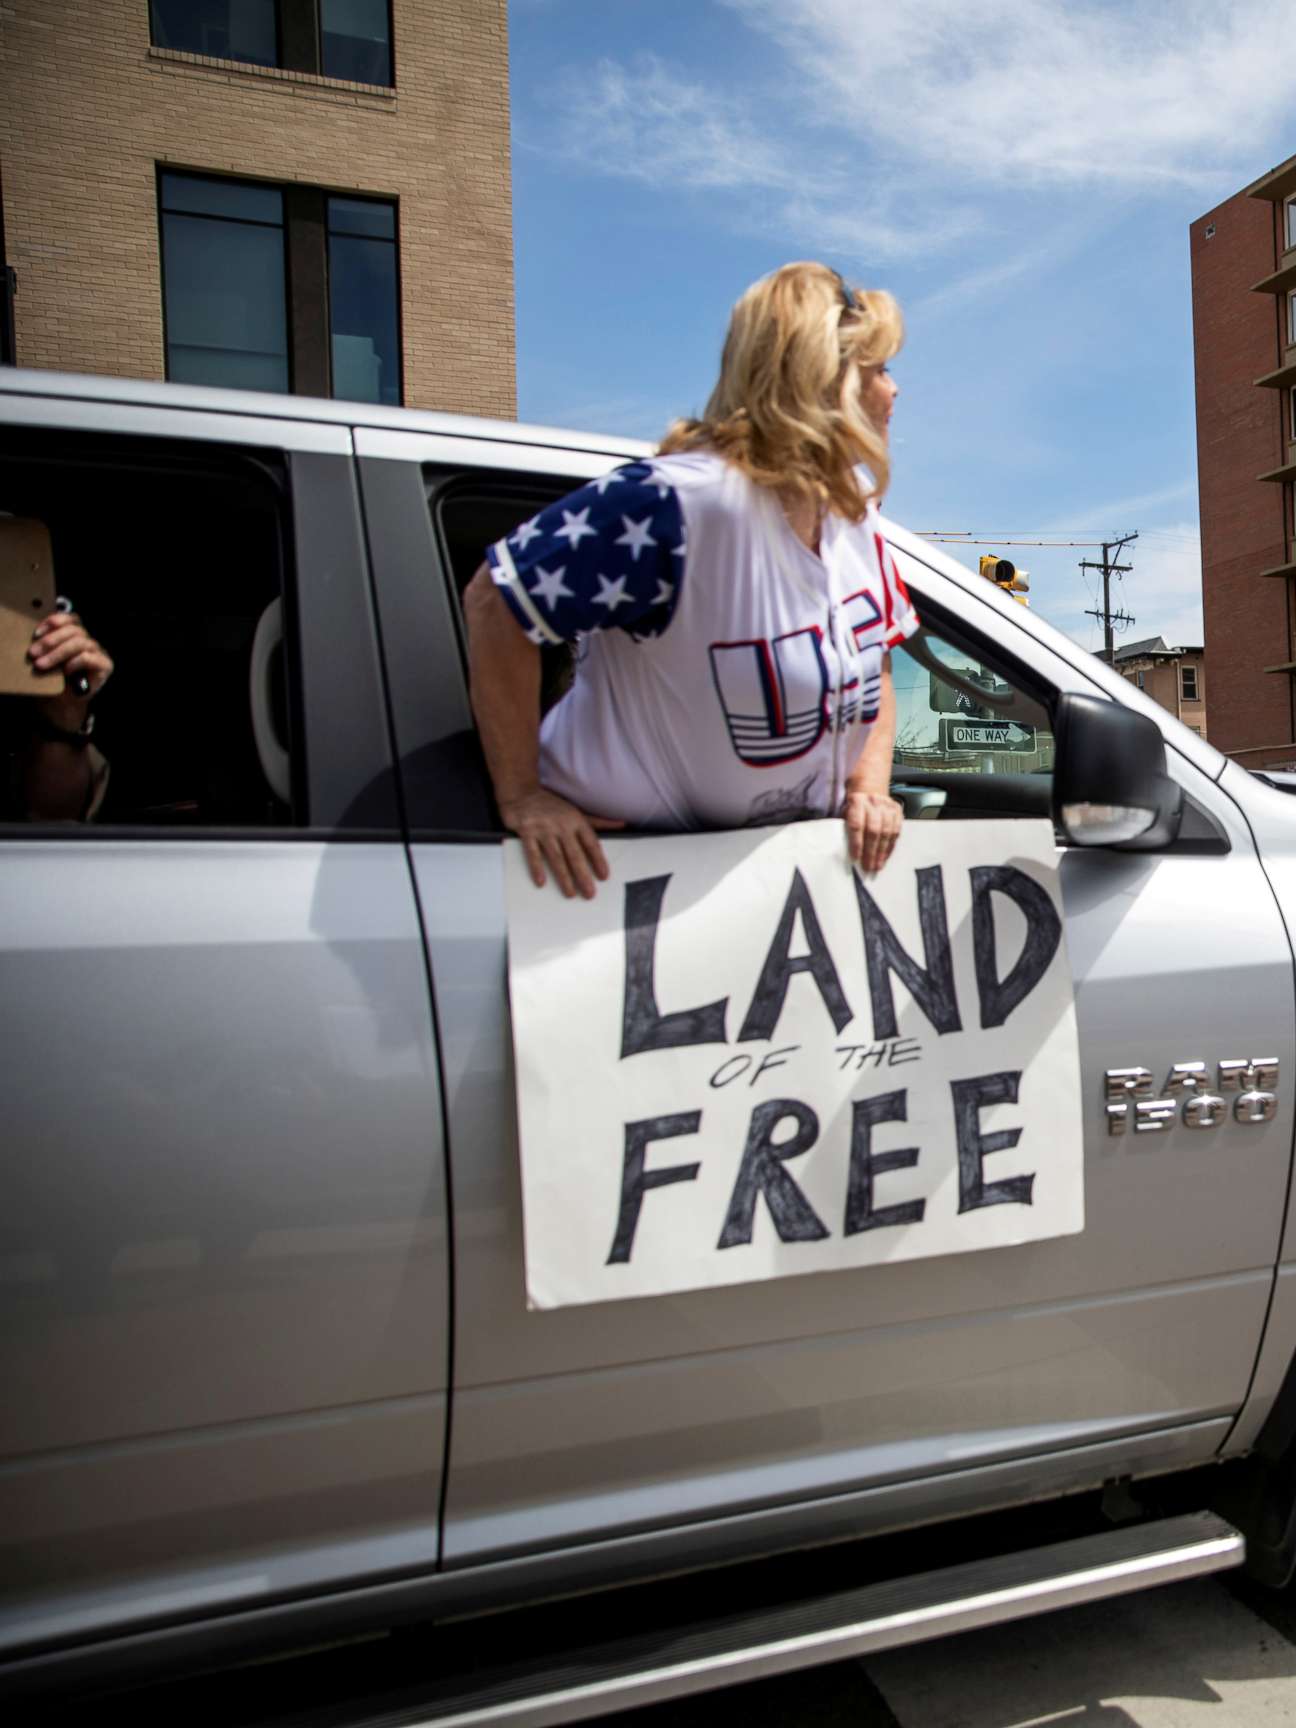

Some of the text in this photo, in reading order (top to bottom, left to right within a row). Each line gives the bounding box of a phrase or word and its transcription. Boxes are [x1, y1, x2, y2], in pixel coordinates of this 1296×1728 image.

[956, 729, 1009, 742] ONE WAY
[619, 864, 1063, 1060] LAND
[709, 1037, 923, 1089] OF THE
[1104, 1057, 1279, 1100] RAM
[1106, 1091, 1279, 1136] 1500
[605, 1070, 1037, 1266] FREE
